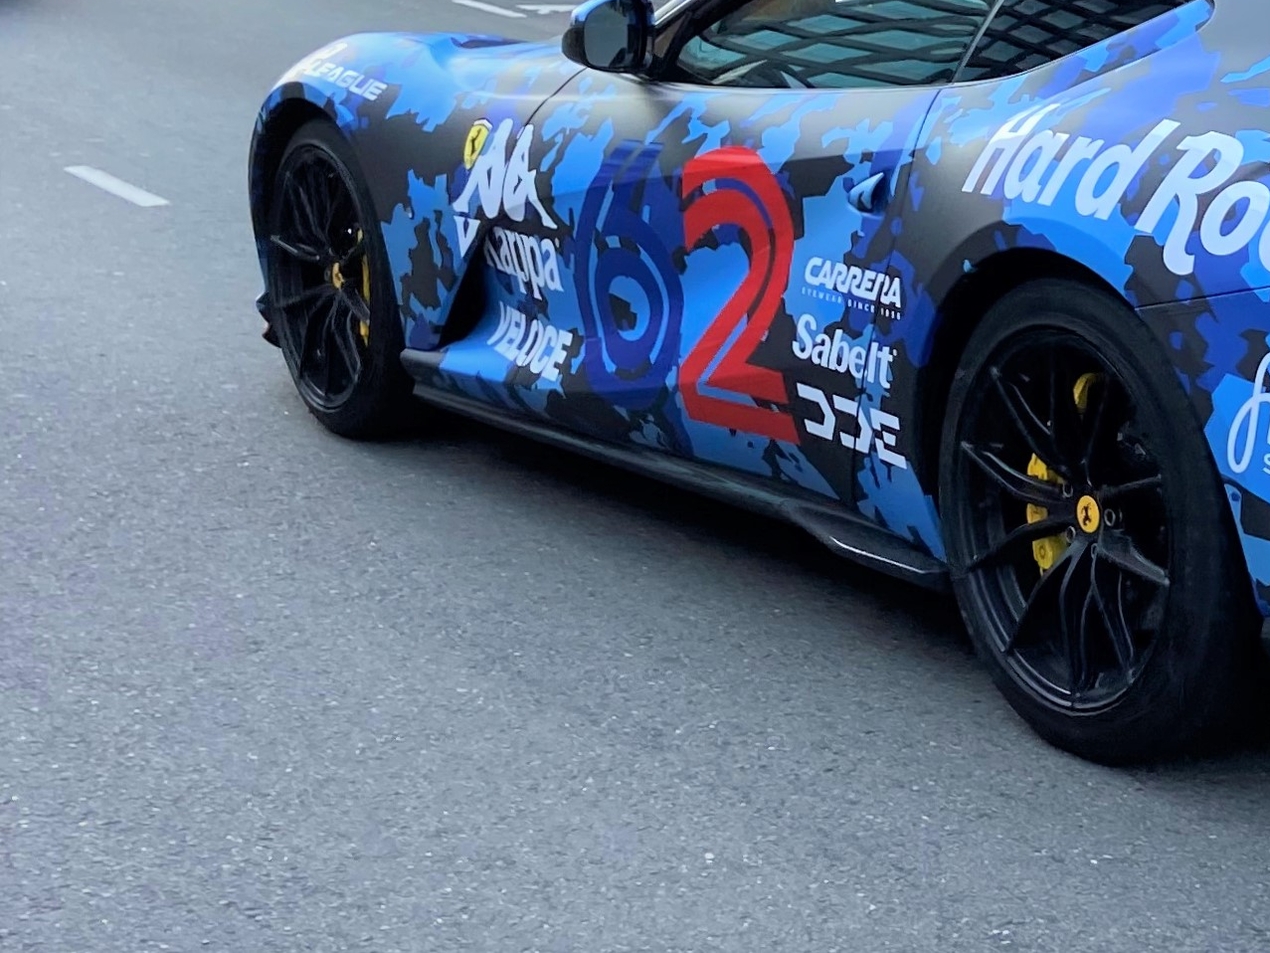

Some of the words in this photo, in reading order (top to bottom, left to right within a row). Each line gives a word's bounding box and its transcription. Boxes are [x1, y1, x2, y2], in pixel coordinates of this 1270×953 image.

[303, 58, 389, 102] LEAGUE
[961, 101, 1181, 221] Hard
[574, 137, 802, 446] 62
[804, 256, 902, 309] CARRERA
[486, 300, 574, 382] VELOCE
[792, 313, 894, 390] Sabelt
